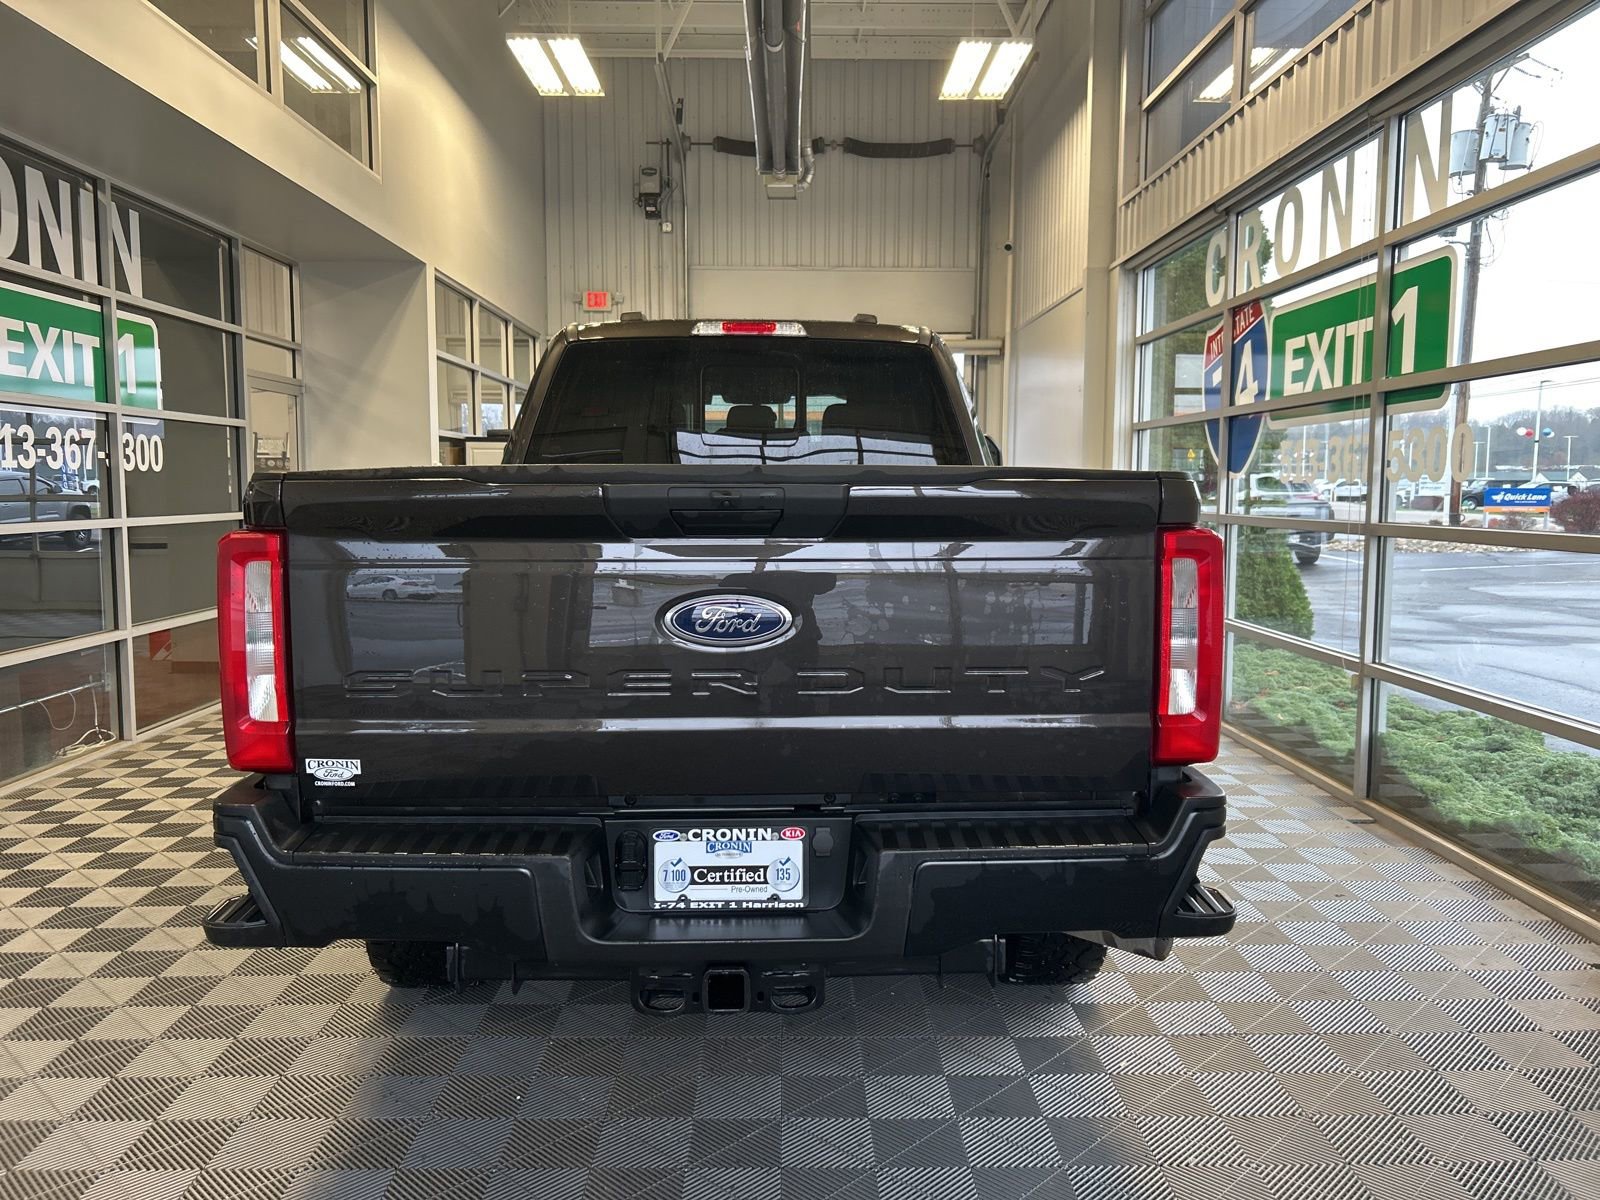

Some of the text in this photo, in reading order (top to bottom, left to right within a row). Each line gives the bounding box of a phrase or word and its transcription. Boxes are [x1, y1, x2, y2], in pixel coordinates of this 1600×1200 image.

[1283, 285, 1418, 397] EXIT 1
[0, 317, 137, 394] EXIT 1
[1504, 493, 1547, 501] Quick Lane
[695, 605, 761, 633] Ford
[344, 667, 1105, 698] SUPER DUTY
[308, 760, 359, 771] CRONIN
[323, 769, 345, 778] Ford
[687, 828, 772, 841] CRONIN
[785, 829, 801, 837] KIA
[707, 841, 751, 852] CRONIN
[693, 868, 765, 883] Certified
[776, 868, 791, 881] 135
[690, 901, 725, 909] EXIT
